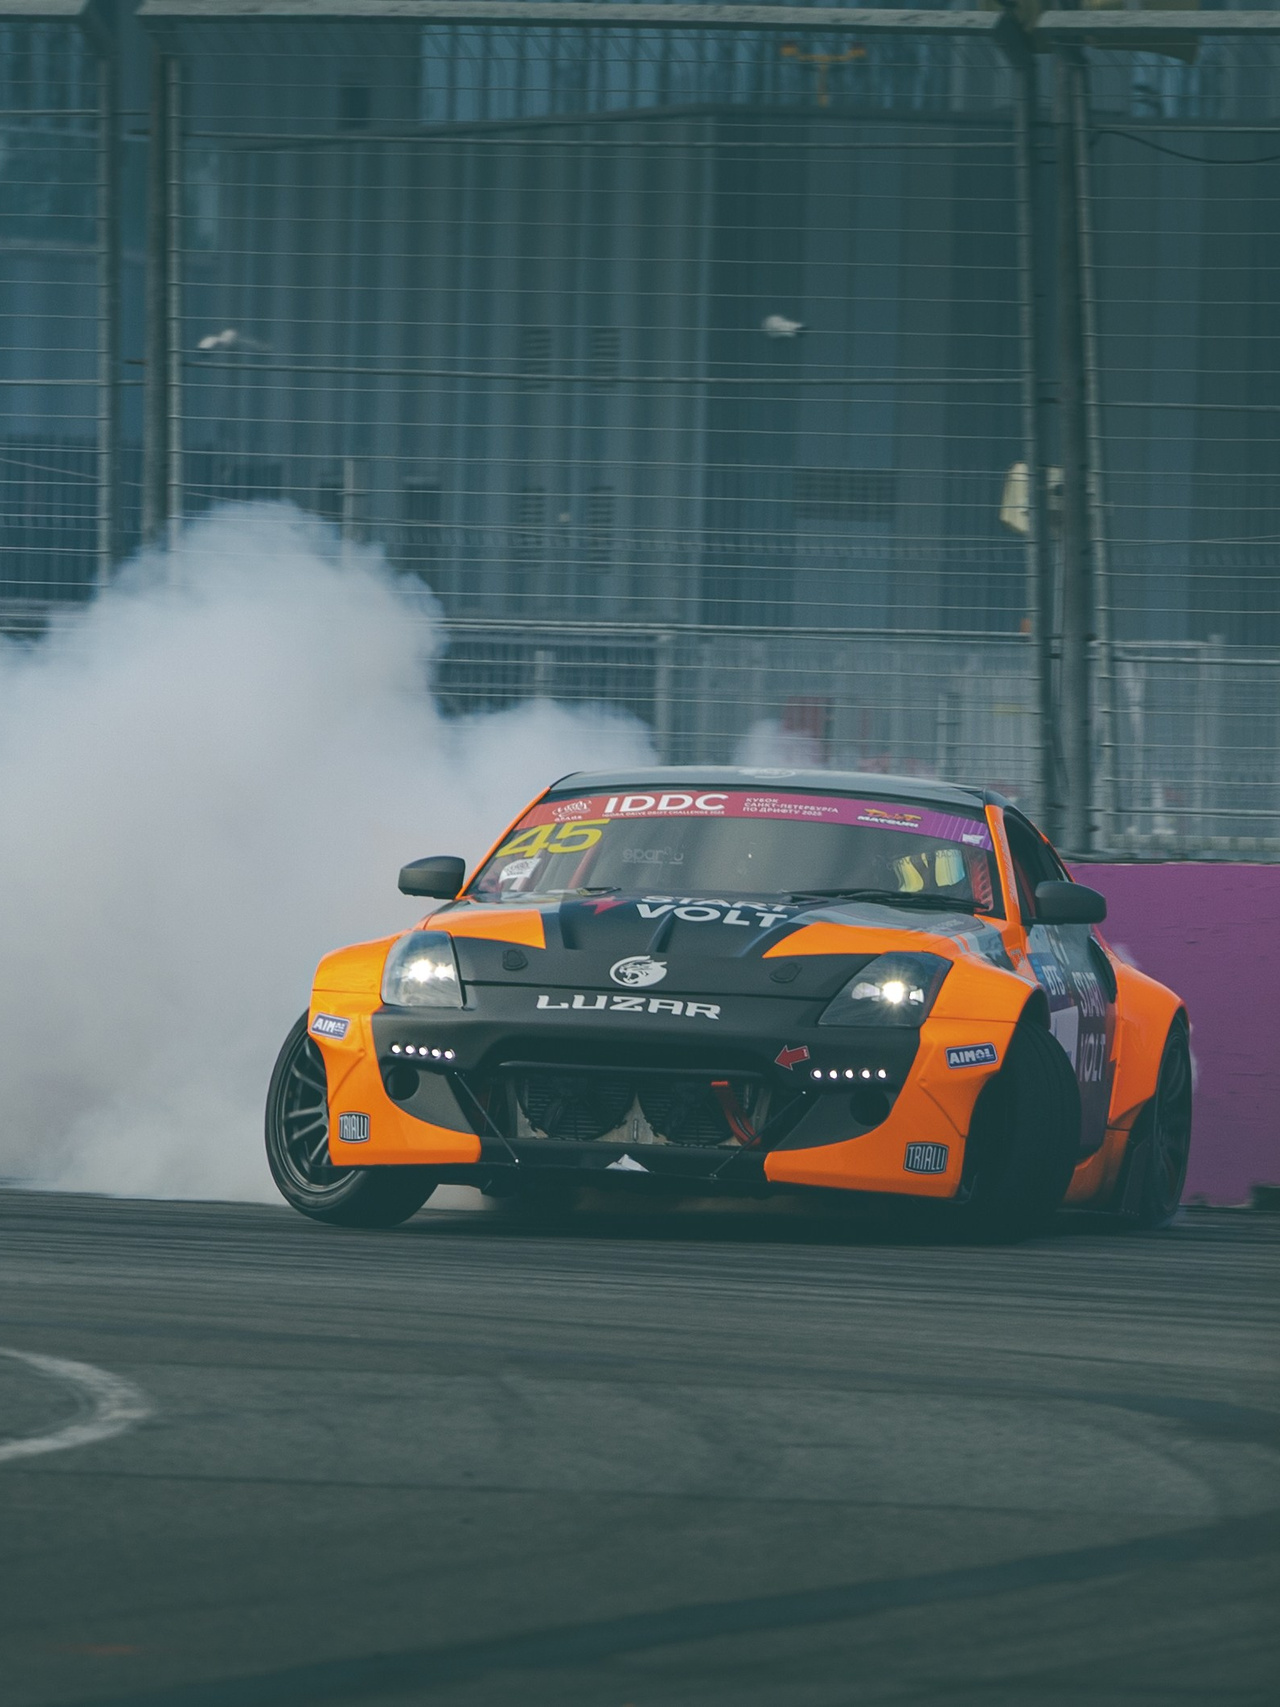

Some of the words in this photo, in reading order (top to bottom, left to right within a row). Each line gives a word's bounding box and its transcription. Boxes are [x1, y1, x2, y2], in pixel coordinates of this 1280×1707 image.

[604, 793, 729, 813] IDDC
[744, 802, 839, 814] САНКТ-ПЕТЕРБУРГА
[495, 818, 611, 858] 45
[636, 903, 788, 927] VOLT
[641, 895, 799, 912] START
[536, 994, 721, 1020] LUZAR
[949, 1048, 994, 1065] AIMOL
[1080, 1033, 1106, 1082] VOLT
[908, 1145, 946, 1171] TRIALLI
